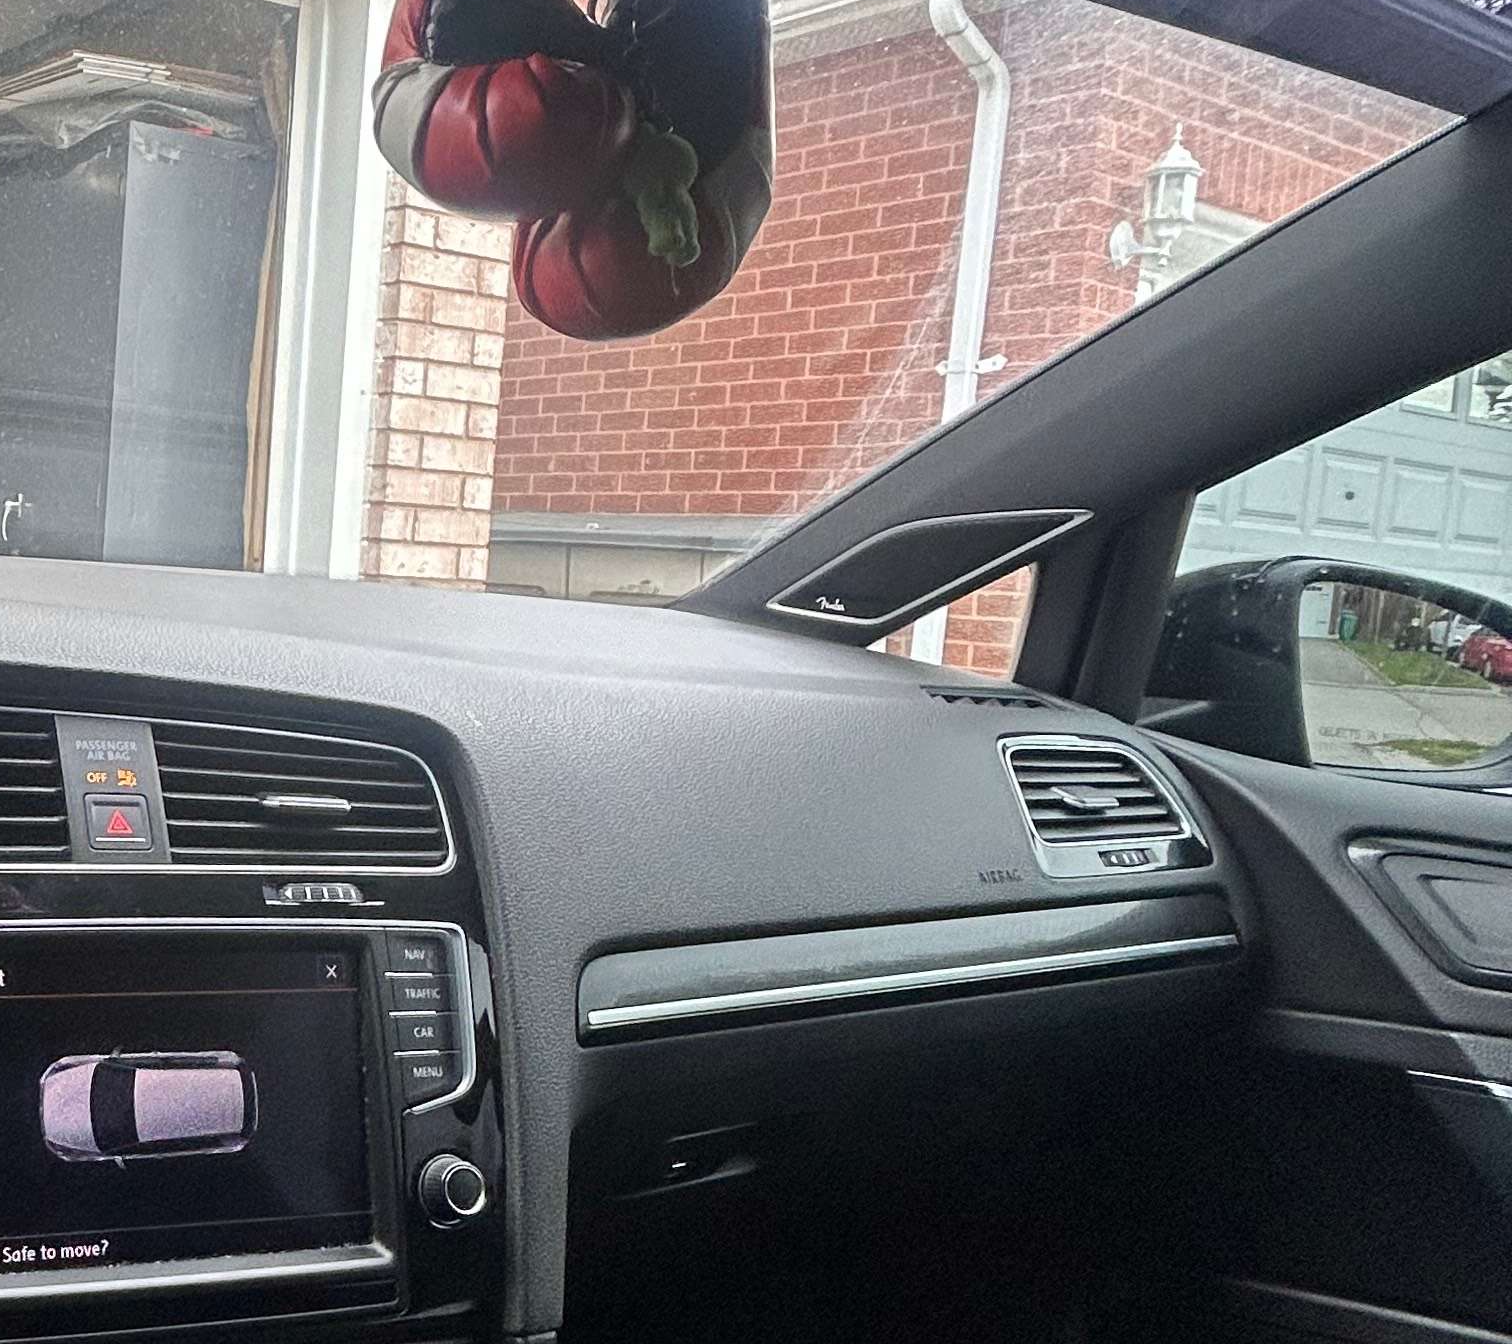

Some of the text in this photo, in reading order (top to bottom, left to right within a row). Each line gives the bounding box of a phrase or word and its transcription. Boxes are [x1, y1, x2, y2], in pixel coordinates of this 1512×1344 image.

[75, 740, 137, 752] PASSENGER
[87, 750, 131, 762] AIR BAG
[86, 771, 108, 784] OFF
[404, 949, 425, 960] NAV
[404, 988, 441, 1000] TRAFFIC
[413, 1027, 435, 1038] CAR
[413, 1067, 443, 1078] MENU
[3, 1246, 36, 1264] Safe
[41, 1244, 56, 1260] to
[60, 1239, 109, 1259] move?
